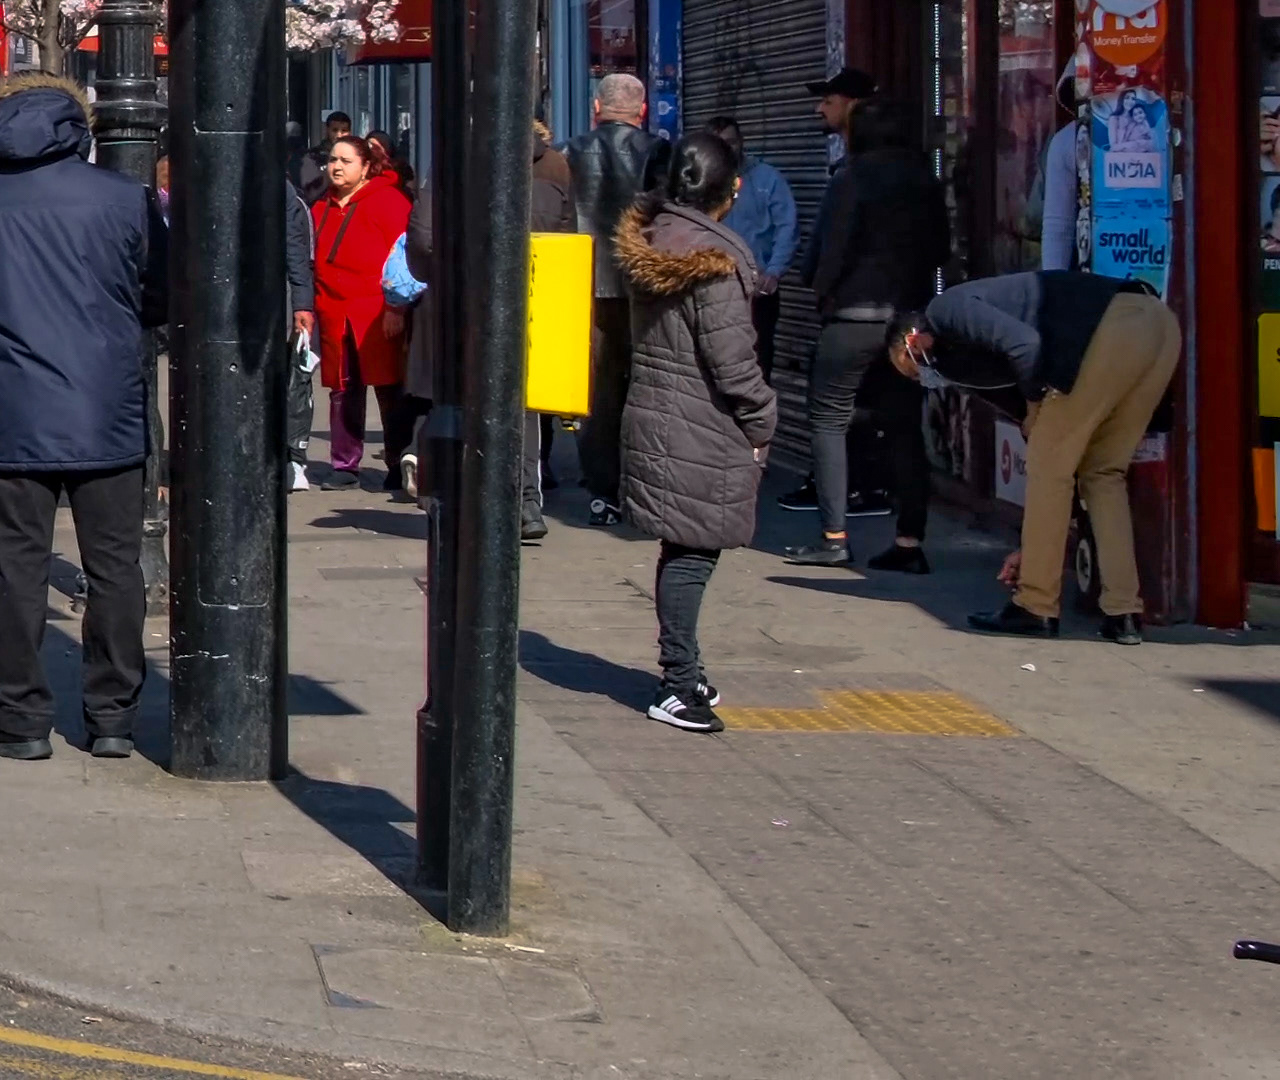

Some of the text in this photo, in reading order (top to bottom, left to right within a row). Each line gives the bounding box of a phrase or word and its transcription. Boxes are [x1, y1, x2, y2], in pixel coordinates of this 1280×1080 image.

[1093, 33, 1157, 47] Money Transfer
[1098, 228, 1149, 248] small
[1111, 245, 1166, 265] world
